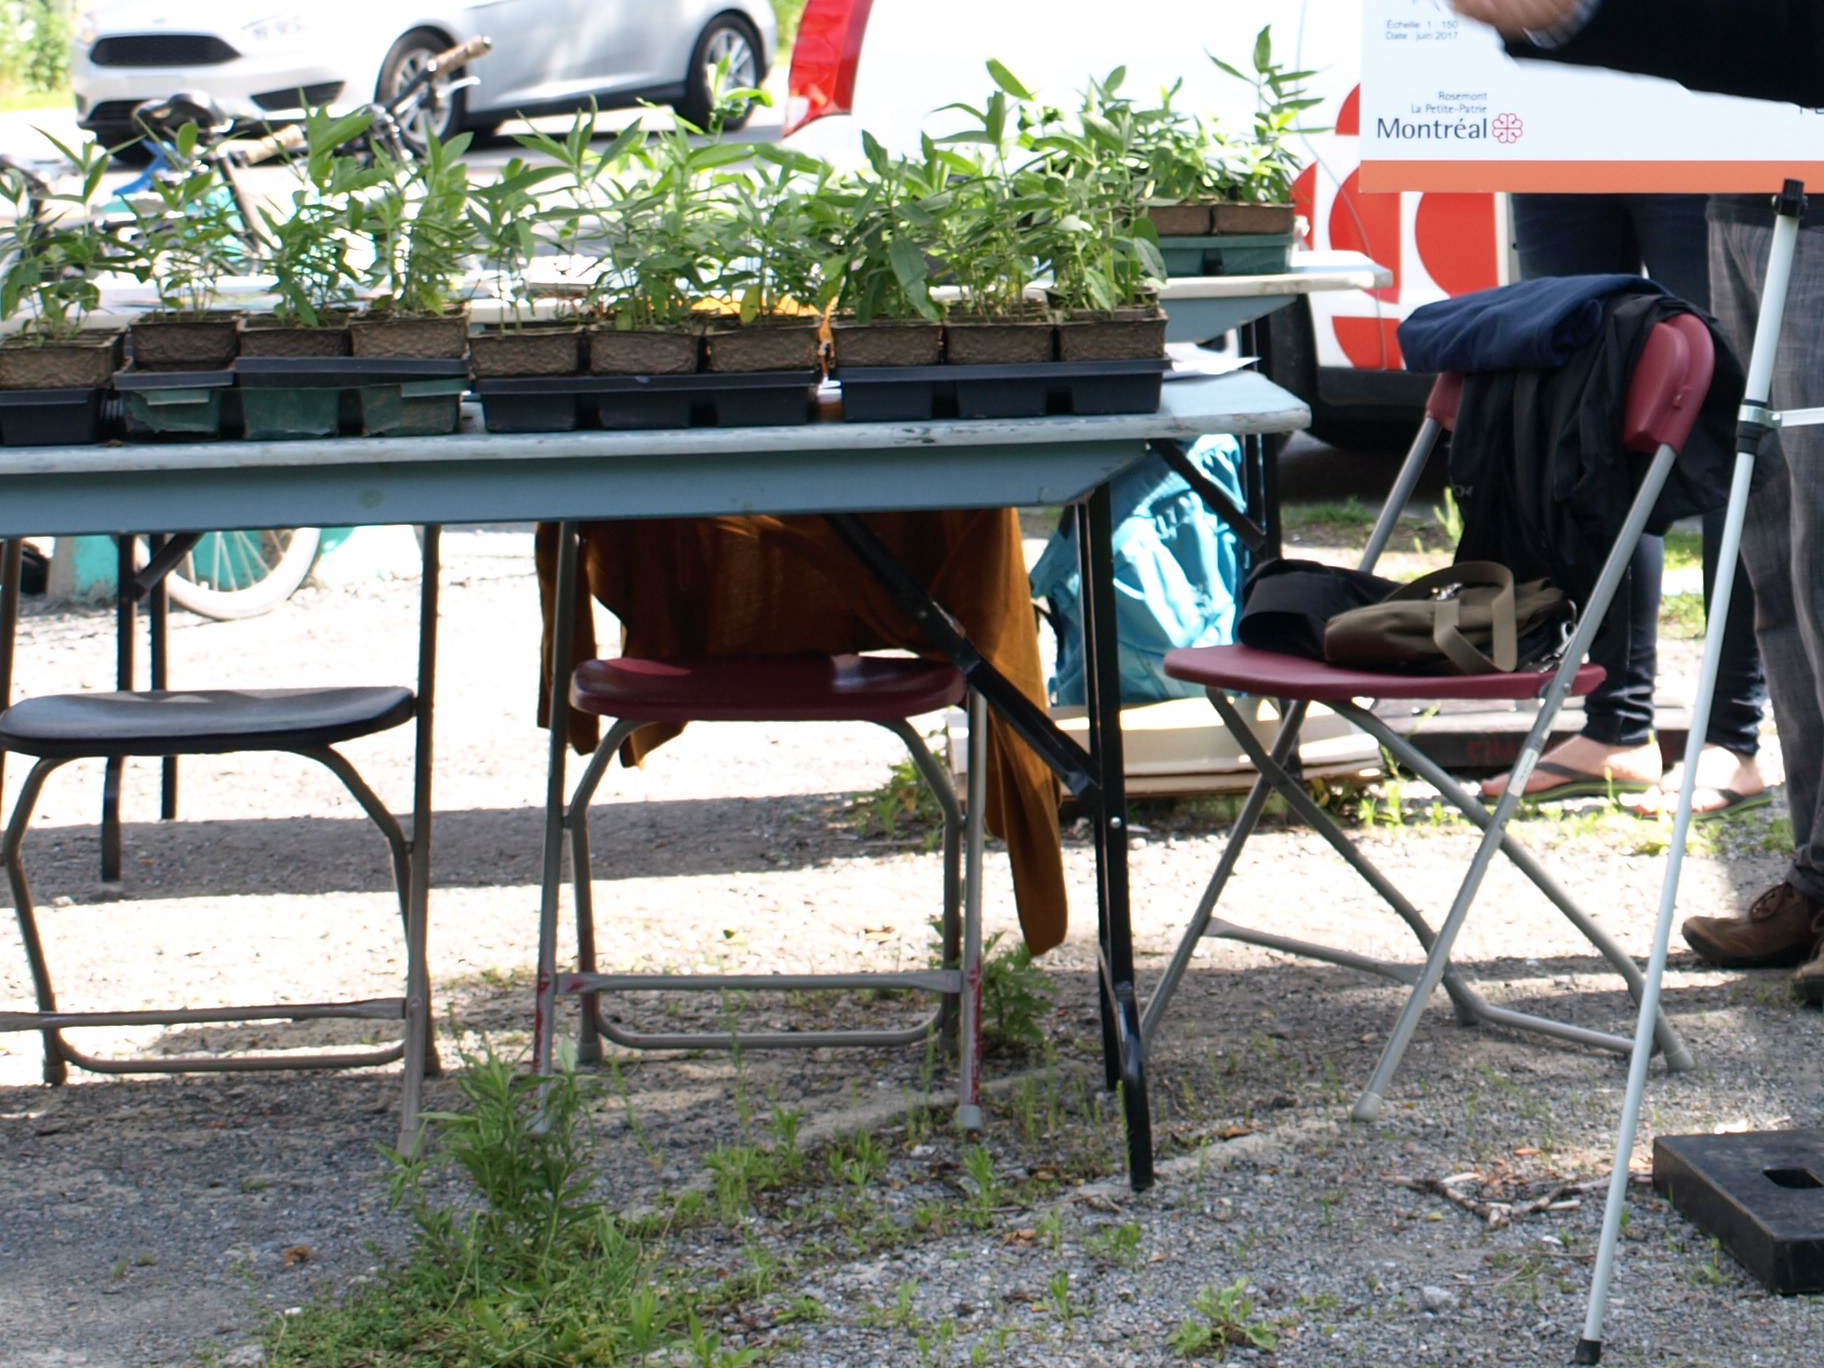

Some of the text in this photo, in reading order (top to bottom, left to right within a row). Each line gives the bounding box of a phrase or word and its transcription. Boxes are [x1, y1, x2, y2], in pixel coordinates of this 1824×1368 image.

[1435, 31, 1458, 40] 2017
[1438, 91, 1487, 101] Rosemont
[1411, 104, 1421, 114] La
[1377, 117, 1487, 139] Montréal
